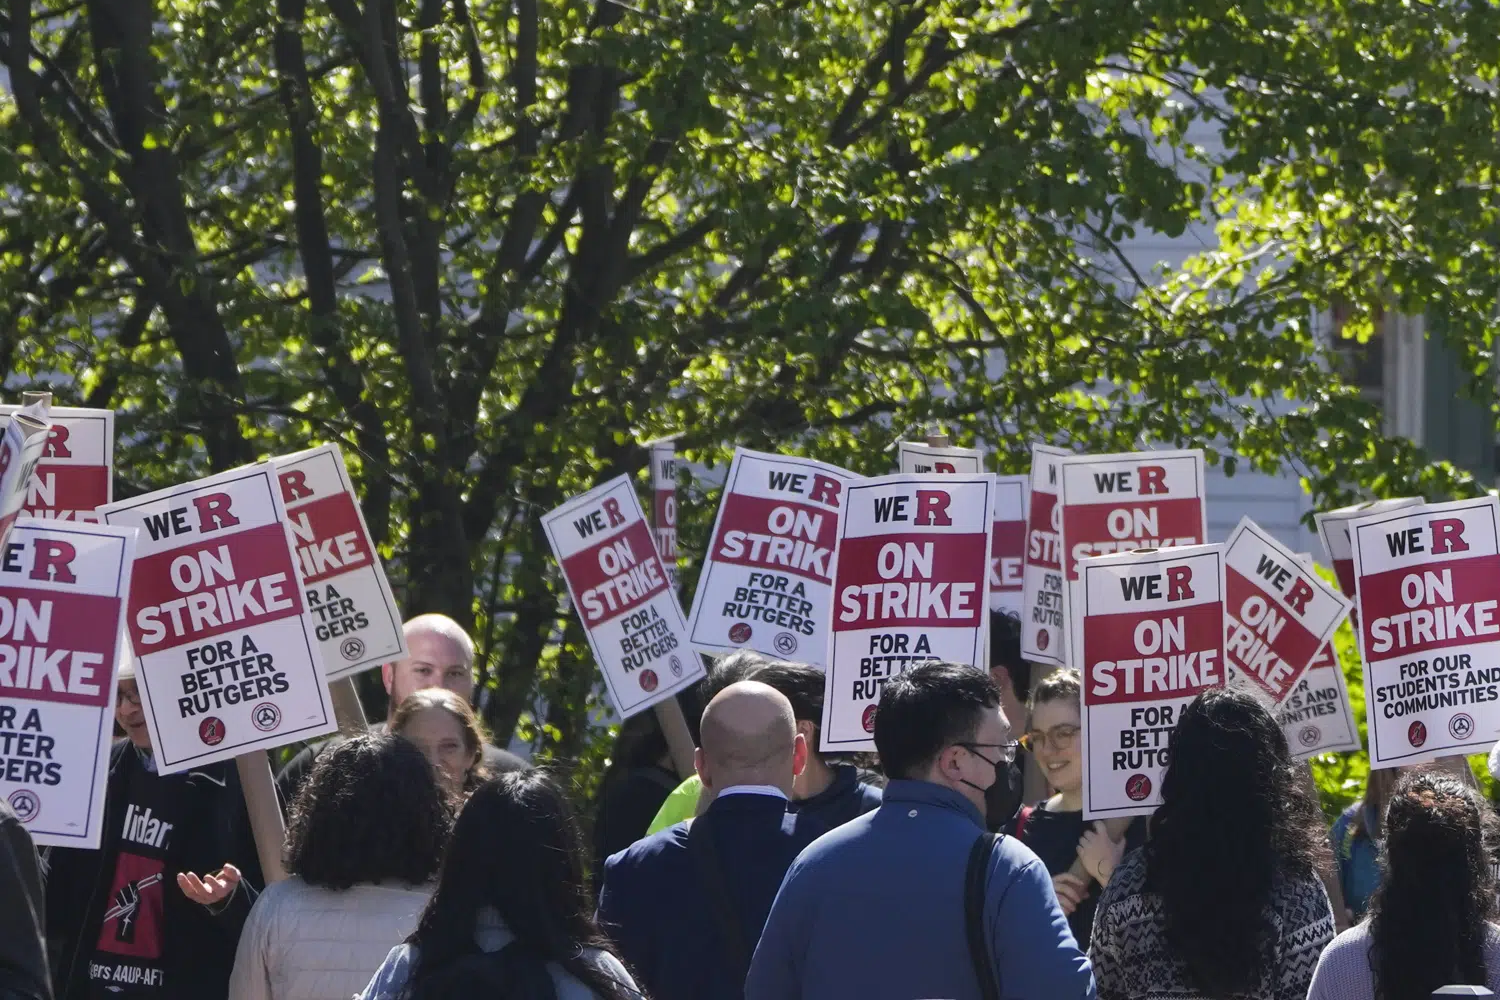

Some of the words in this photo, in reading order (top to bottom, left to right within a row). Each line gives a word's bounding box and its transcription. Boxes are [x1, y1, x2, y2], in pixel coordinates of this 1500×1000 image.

[278, 469, 314, 504] R
[768, 470, 807, 494] WE
[808, 473, 842, 508] R
[1094, 471, 1132, 494] WE
[1137, 465, 1169, 495] R
[143, 507, 192, 541] WE
[192, 492, 240, 533] R
[573, 509, 609, 539] WE
[602, 496, 626, 529] R
[767, 506, 823, 542] ON
[873, 496, 909, 523] WE
[914, 490, 952, 526] R
[1106, 507, 1159, 540] ON
[719, 530, 835, 578] STRIK
[1386, 527, 1425, 558] WE
[1428, 517, 1469, 555] R
[29, 538, 77, 584] R
[170, 545, 236, 593] ON
[598, 537, 637, 577] ON
[877, 541, 934, 580] ON
[325, 584, 341, 601] A
[581, 555, 665, 622] STRIKE
[748, 572, 789, 592] FOR
[793, 581, 806, 598] A
[1120, 574, 1162, 602] WE
[1166, 565, 1195, 602] R
[1255, 553, 1292, 593] WE
[1283, 576, 1314, 617] R
[1400, 568, 1454, 609] ON
[136, 572, 293, 645] STRIKE
[620, 609, 648, 635] FOR
[649, 603, 660, 620] A
[722, 602, 816, 636] RUTGERS
[733, 588, 813, 618] BETTER
[839, 582, 976, 623] STRIKE
[1240, 595, 1287, 645] ON
[618, 619, 670, 655] BETTER
[869, 634, 909, 655] FOR
[914, 633, 931, 654] A
[1133, 616, 1186, 656] ON
[1370, 600, 1500, 653] STRIKE
[186, 639, 233, 670] FOR
[240, 635, 260, 656] A
[621, 633, 679, 673] RUTGERS
[1399, 660, 1429, 681] FOR
[1433, 653, 1472, 673] OUR
[180, 652, 276, 695] BETTER
[1091, 649, 1219, 697] STRIKE
[1376, 671, 1460, 702] STUDENTS
[177, 672, 289, 718] RUTGERS
[1307, 687, 1338, 706] AND
[1383, 685, 1499, 719] COMMUNITIES
[22, 708, 43, 732] A
[1130, 706, 1173, 728] FOR
[113, 965, 165, 986] AAUP-AFT
